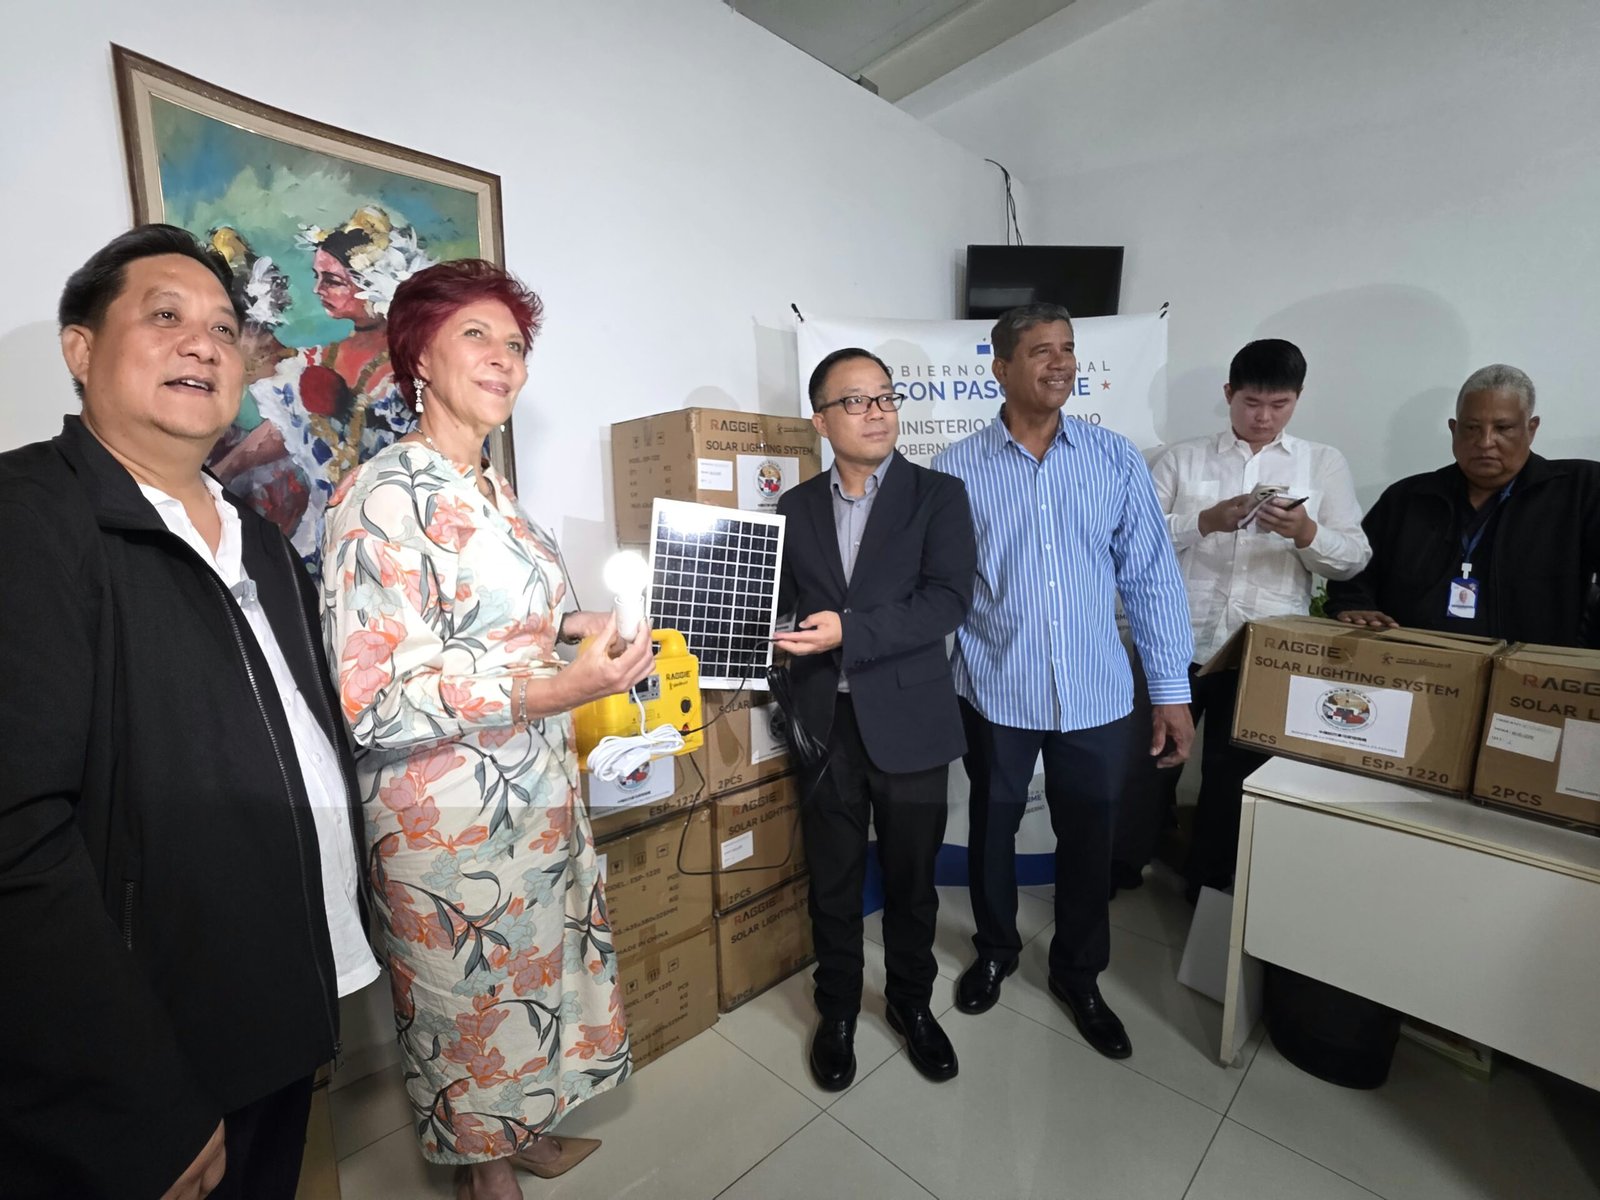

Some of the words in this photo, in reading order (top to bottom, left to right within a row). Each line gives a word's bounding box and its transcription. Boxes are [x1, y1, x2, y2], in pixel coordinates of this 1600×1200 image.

[887, 365, 985, 377] OBIERNO
[893, 380, 946, 401] CON
[710, 418, 760, 434] RAGGIE
[899, 418, 986, 436] INISTERIO
[706, 440, 738, 452] SOLAR
[742, 442, 783, 455] LIGHTING
[783, 445, 815, 457] SYSTEM
[1264, 637, 1343, 660] RAGGIE
[665, 670, 692, 681] RAGGIE
[1254, 655, 1302, 673] SOLAR
[1306, 664, 1387, 687] LIGHTING
[1392, 677, 1461, 699] SYSTEM
[1522, 674, 1600, 698] RAGG
[719, 700, 750, 714] SOLAR
[1509, 695, 1578, 719] SOLAR
[1240, 728, 1278, 746] 2PCS
[1361, 755, 1450, 785] ESP-1220
[717, 774, 743, 790] 2PCS
[732, 791, 777, 817] RAGGIE
[1491, 784, 1543, 807] 2PCS
[728, 817, 758, 836] SOLAR
[730, 922, 760, 944] SOLAR
